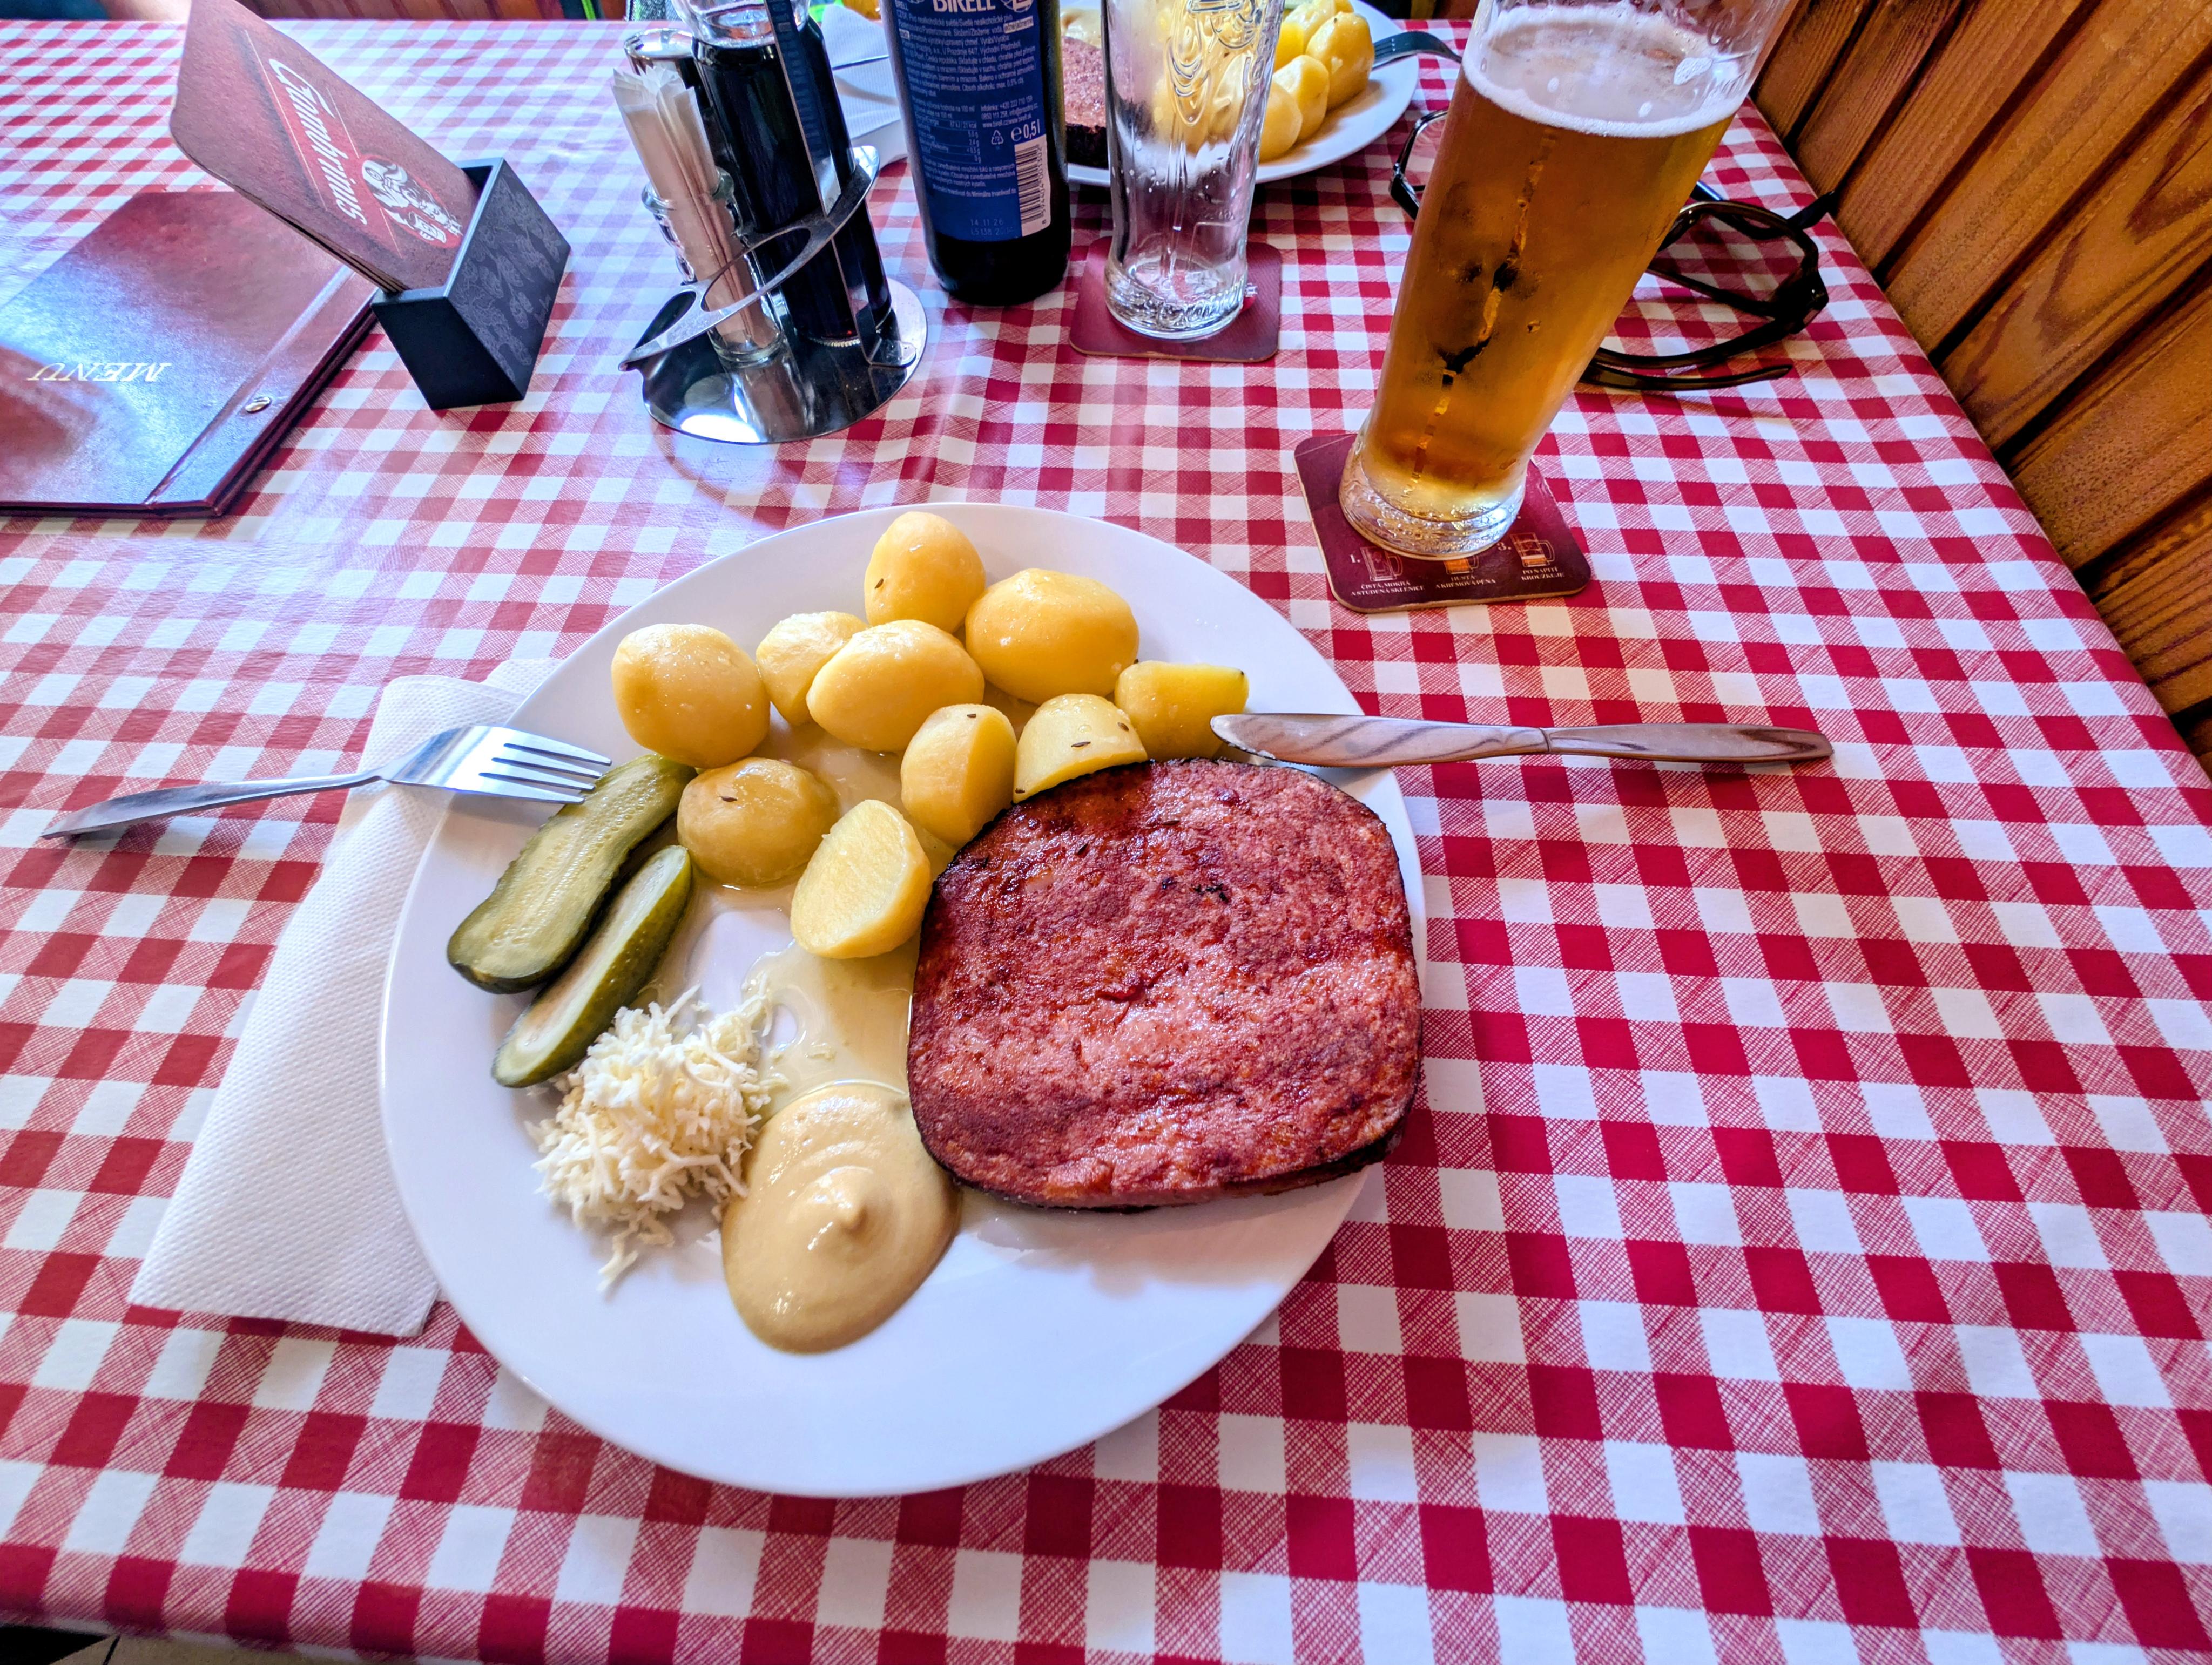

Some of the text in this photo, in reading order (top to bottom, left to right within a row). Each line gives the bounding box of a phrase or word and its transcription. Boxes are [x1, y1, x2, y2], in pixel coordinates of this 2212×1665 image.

[268, 58, 368, 225] Gambrinus
[27, 362, 172, 382] MENU
[1496, 542, 1512, 551] 3.
[1350, 554, 1361, 563] 1.
